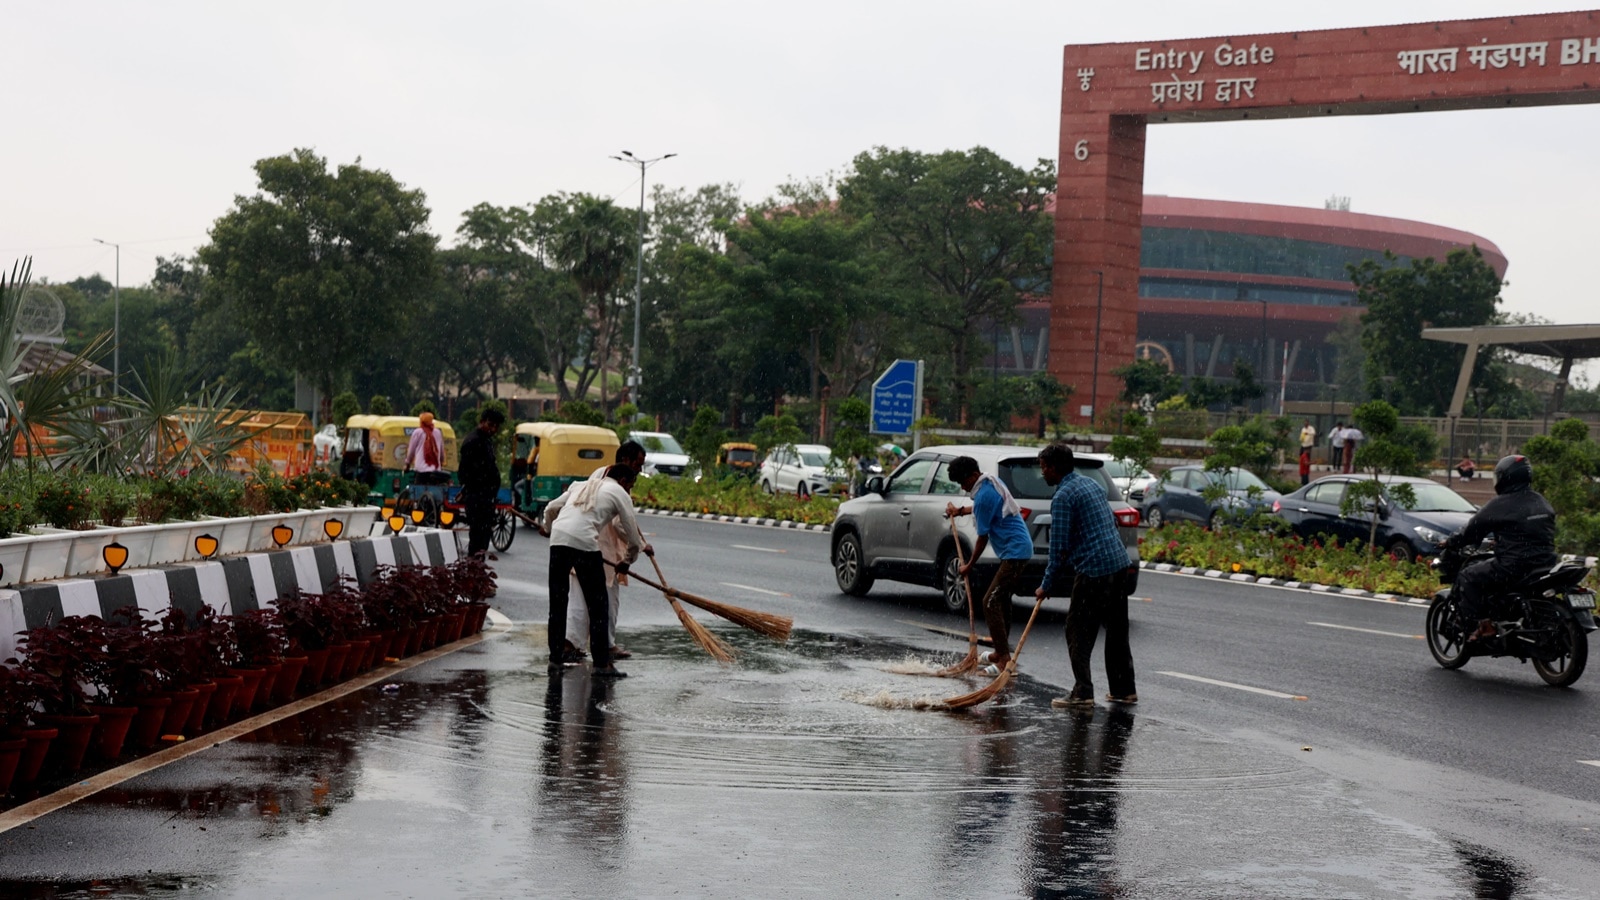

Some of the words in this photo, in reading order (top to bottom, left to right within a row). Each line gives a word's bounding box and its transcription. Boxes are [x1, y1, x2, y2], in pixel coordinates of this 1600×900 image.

[1135, 47, 1204, 74] Entry
[1214, 42, 1275, 67] Gate
[1397, 47, 1460, 75] भारत
[1466, 37, 1549, 71] मंडपम
[1560, 37, 1600, 66] BH
[1150, 73, 1205, 104] प्रवेश
[1214, 77, 1257, 102] द्वार
[1074, 139, 1089, 161] 6
